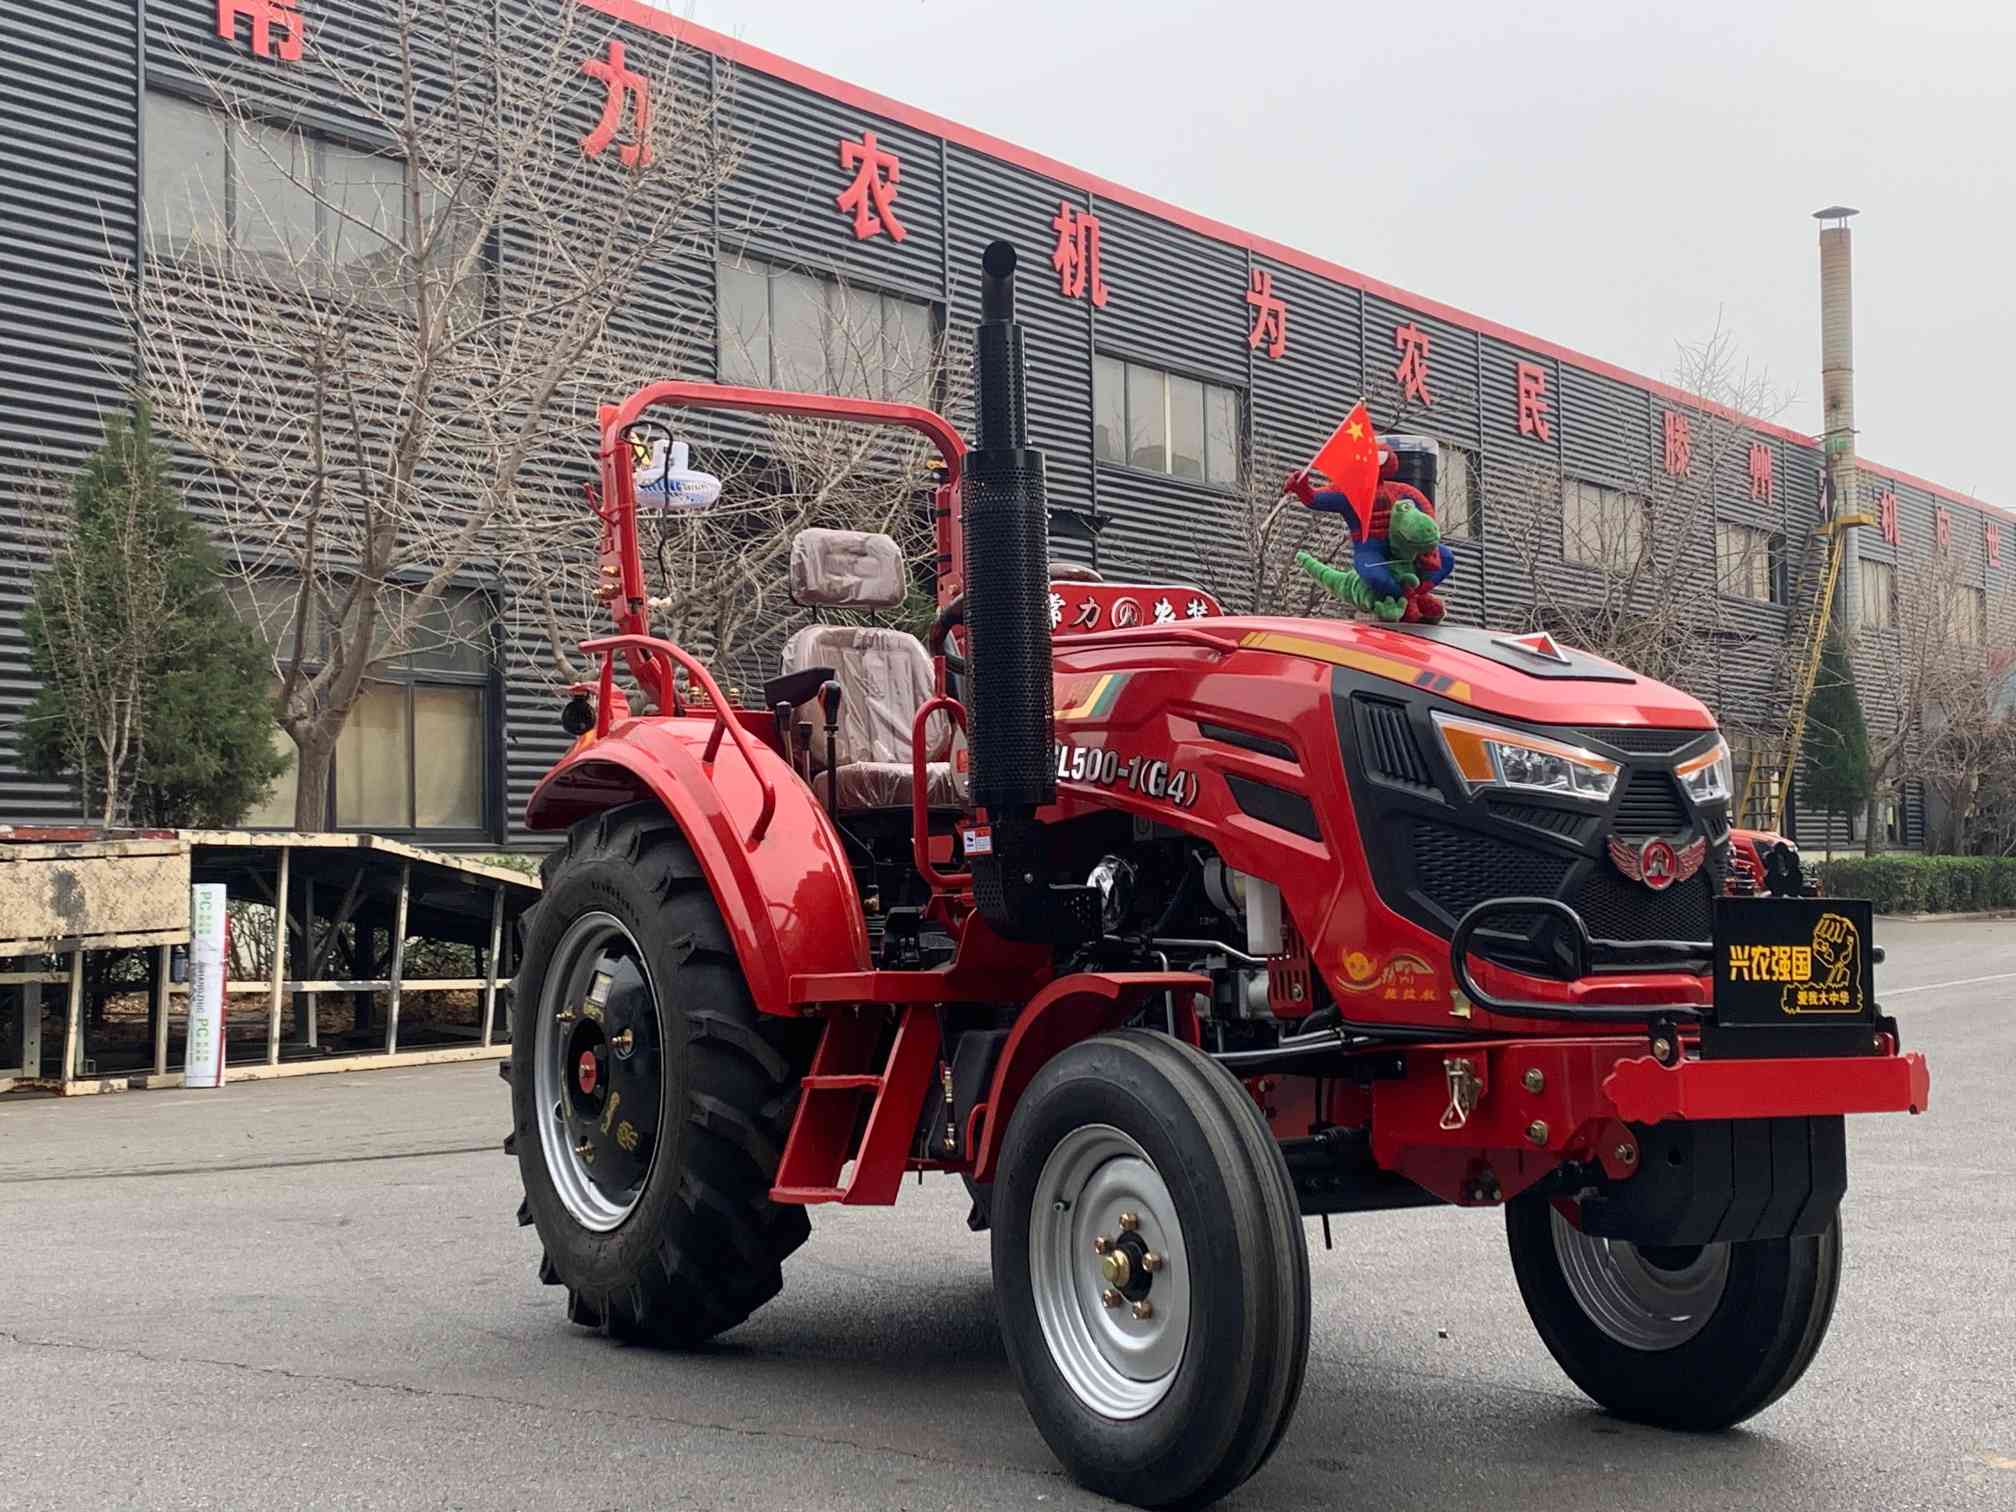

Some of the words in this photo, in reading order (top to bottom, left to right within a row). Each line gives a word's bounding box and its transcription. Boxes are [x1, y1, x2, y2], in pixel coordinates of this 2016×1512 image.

[1055, 743, 1198, 807] L500-1(G4)
[1728, 944, 1812, 982] 兴农强国
